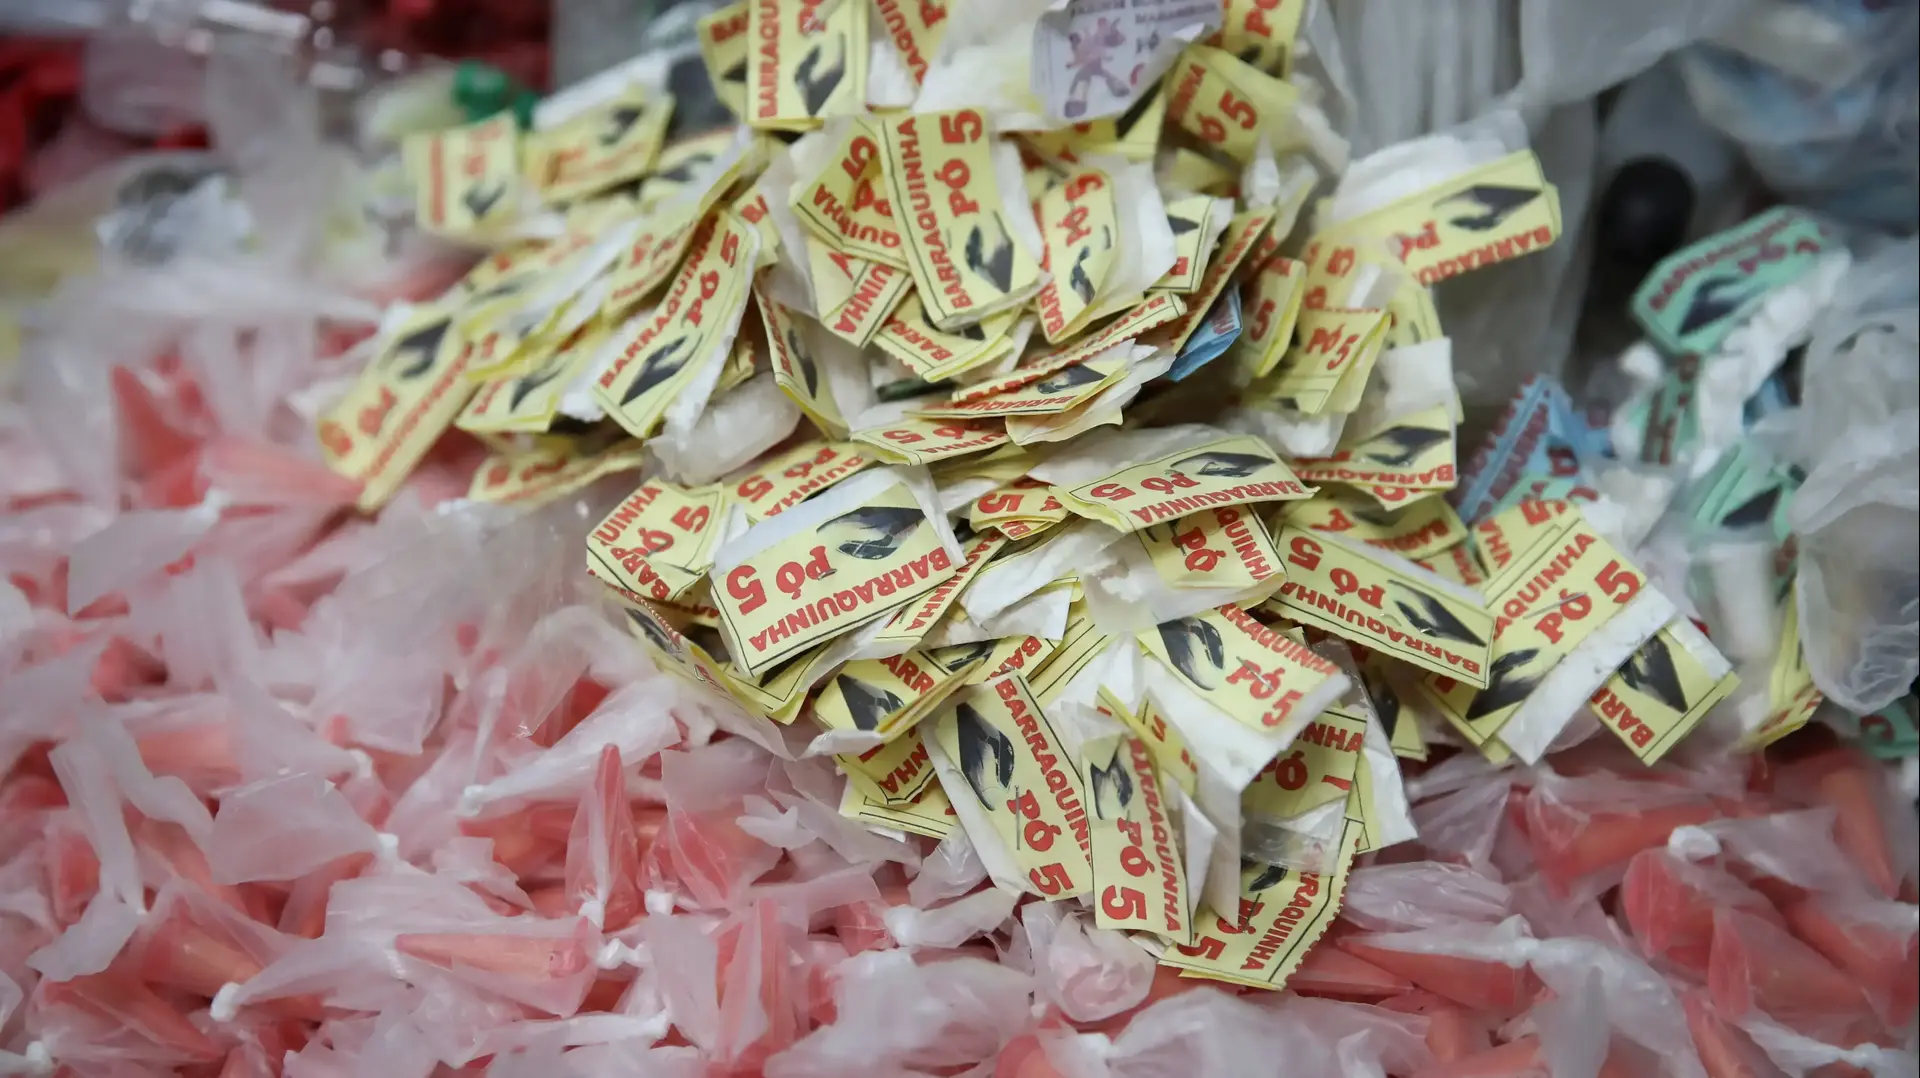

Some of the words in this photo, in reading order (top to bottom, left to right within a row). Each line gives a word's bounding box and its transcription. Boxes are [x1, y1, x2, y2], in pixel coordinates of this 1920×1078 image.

[939, 109, 983, 144] 5
[1218, 89, 1258, 131] 5
[841, 135, 878, 182] 5
[933, 158, 980, 218] PÓ
[896, 116, 974, 309] BARRAQUINHA
[686, 270, 719, 328] PÓ
[882, 429, 926, 444] 5
[784, 447, 838, 479] PÓ
[1140, 471, 1200, 496] PÓ
[737, 475, 775, 503] 5
[977, 493, 1025, 514] 5
[1091, 483, 1137, 501] 5
[1130, 480, 1303, 524] BARRAQUINHA
[594, 485, 664, 547] UINHA
[671, 504, 710, 534] 5
[1178, 526, 1227, 573] PÓ
[1213, 506, 1275, 582] QUINHA
[1287, 535, 1324, 572] 5
[726, 564, 768, 616] 5
[776, 545, 833, 601] PÓ
[1329, 567, 1387, 610] PÓ
[749, 546, 952, 652] BARRAQUINHA
[1534, 588, 1593, 645] PÓ
[1594, 559, 1641, 604] 5
[1280, 581, 1480, 675] BARRAQUINHA
[1225, 659, 1286, 700] PÓ
[1262, 690, 1304, 728] 5
[1298, 721, 1364, 753] NHA
[993, 678, 1093, 868] BARRAQUIN
[1006, 789, 1062, 852] PÓ
[1126, 734, 1182, 932] BARRAQUINHA
[1117, 816, 1156, 878] PÓ
[1029, 862, 1075, 897] 5
[1101, 884, 1148, 921] 5
[1176, 932, 1228, 961] 5
